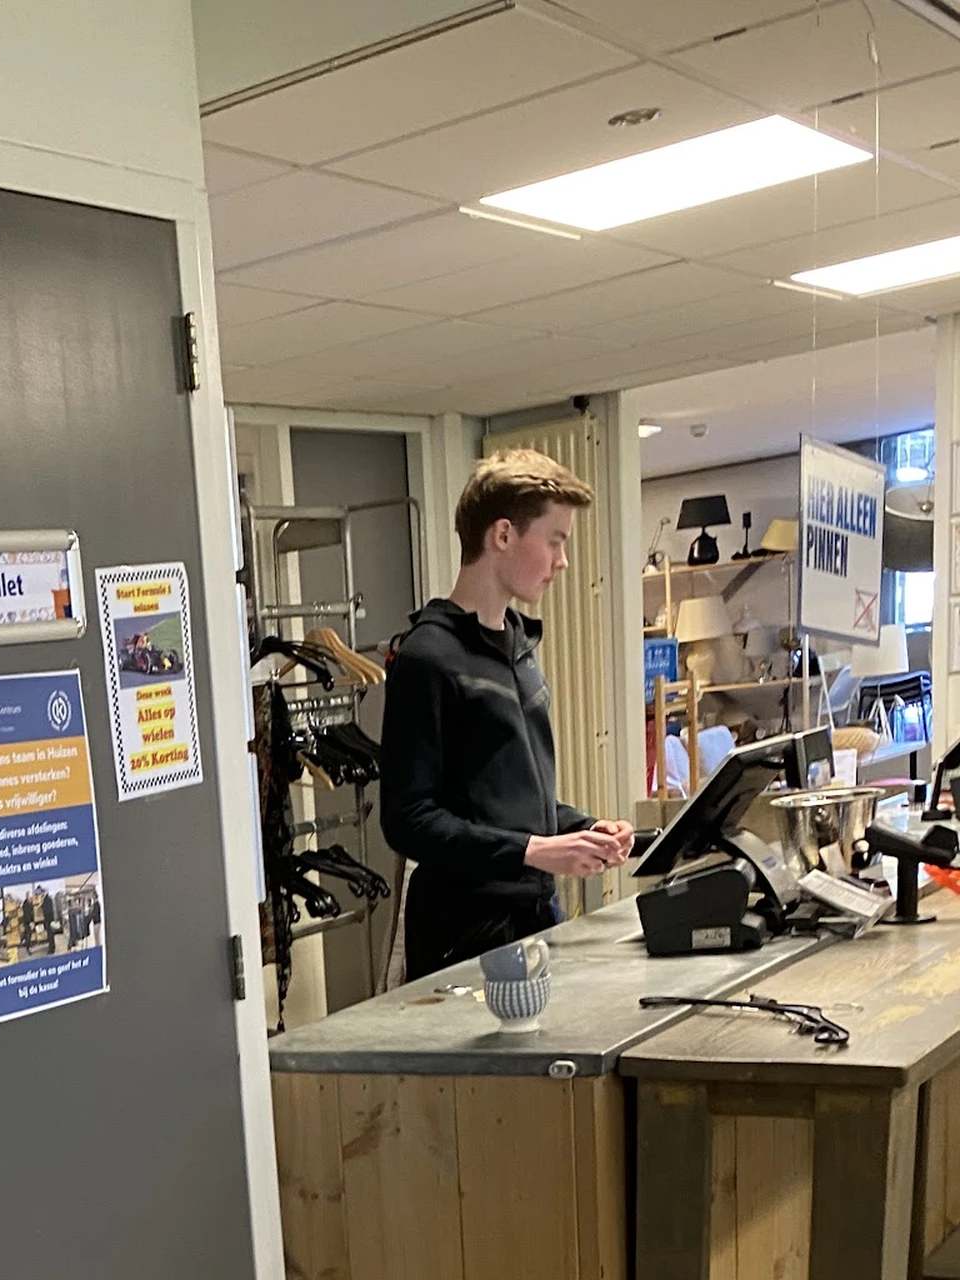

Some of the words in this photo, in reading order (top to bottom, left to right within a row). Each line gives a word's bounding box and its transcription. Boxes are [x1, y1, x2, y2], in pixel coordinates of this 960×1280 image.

[807, 475, 834, 526] HIER
[836, 485, 877, 539] ALLEEN
[806, 524, 848, 578] PINNEN
[137, 708, 162, 723] Alles
[164, 707, 176, 720] op
[142, 728, 175, 743] wielen
[12, 751, 35, 763] team
[36, 748, 45, 760] in
[47, 744, 78, 759] Huizen
[130, 754, 150, 771] 20%
[151, 748, 189, 767] Korting
[20, 766, 70, 784] versterken?
[5, 788, 57, 809] vrijwilliger?
[12, 842, 40, 856] inbreng
[42, 837, 78, 853] goederen,
[22, 862, 32, 871] en
[33, 855, 58, 869] winkel
[8, 970, 39, 985] formulier
[40, 967, 47, 977] in
[48, 967, 57, 975] en
[57, 960, 71, 975] geef
[71, 959, 82, 969] het
[83, 956, 90, 966] af
[18, 986, 29, 998] bij
[29, 984, 38, 995] de
